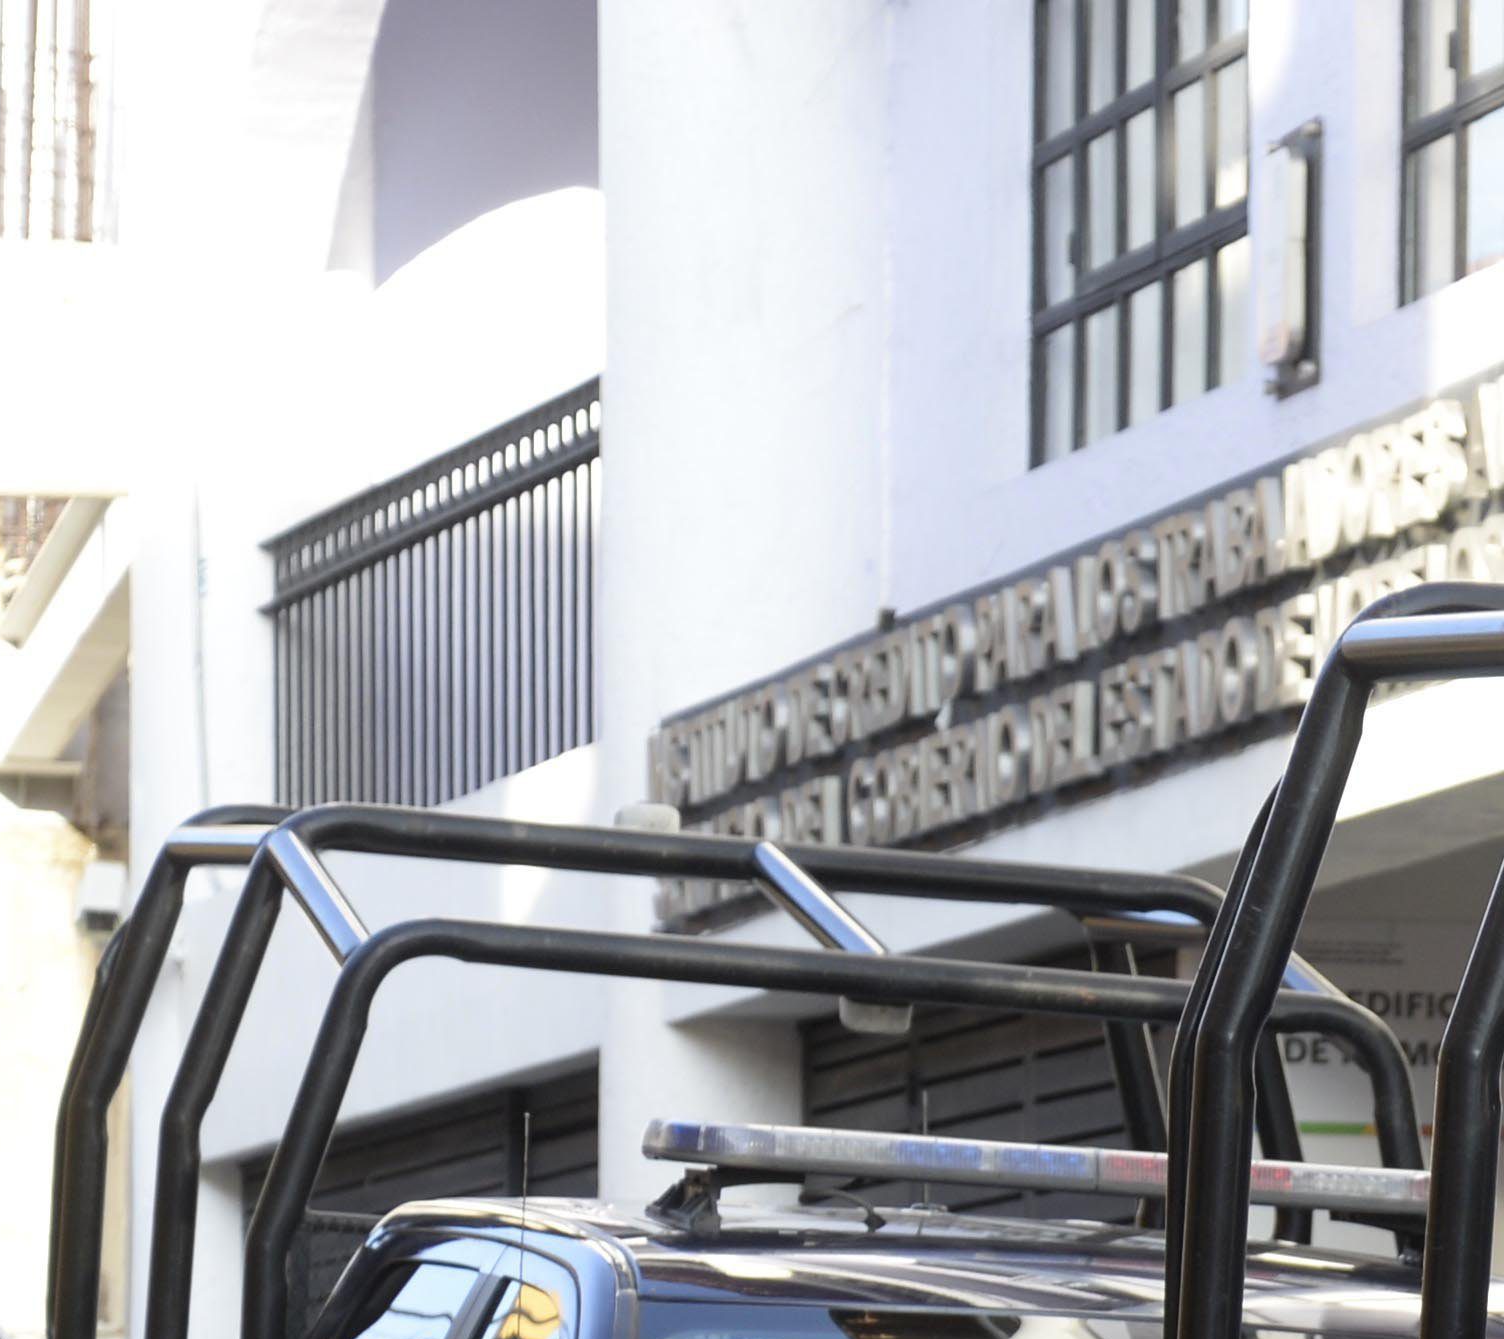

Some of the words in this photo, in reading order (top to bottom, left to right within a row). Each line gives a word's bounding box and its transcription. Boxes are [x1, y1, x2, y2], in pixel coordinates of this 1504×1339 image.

[974, 567, 1078, 693] PARA
[1076, 528, 1158, 652] LOS
[1100, 615, 1260, 770] ESTADO
